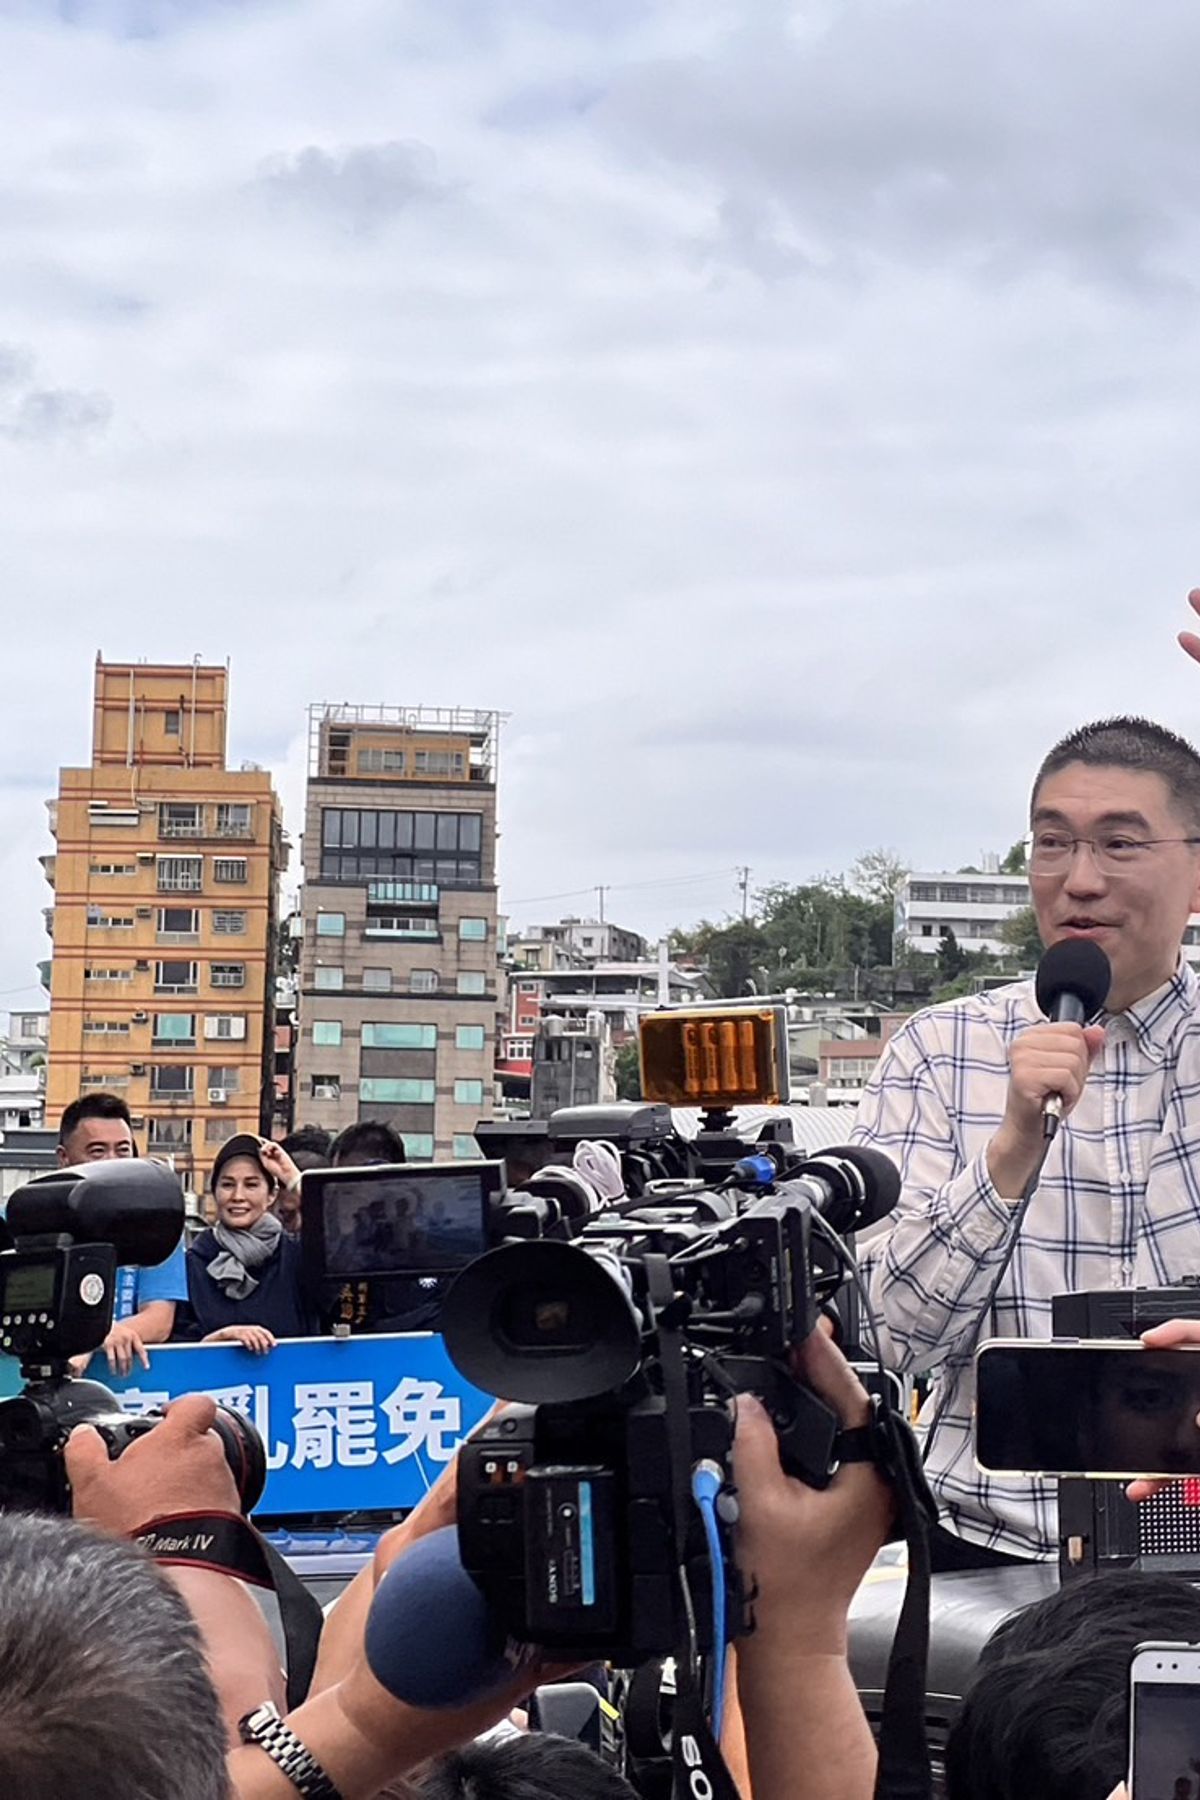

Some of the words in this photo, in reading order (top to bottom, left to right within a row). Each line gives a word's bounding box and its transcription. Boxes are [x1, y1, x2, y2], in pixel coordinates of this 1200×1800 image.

[153, 1535, 193, 1551] Mark
[192, 1534, 215, 1550] IV
[548, 1560, 559, 1604] SONY
